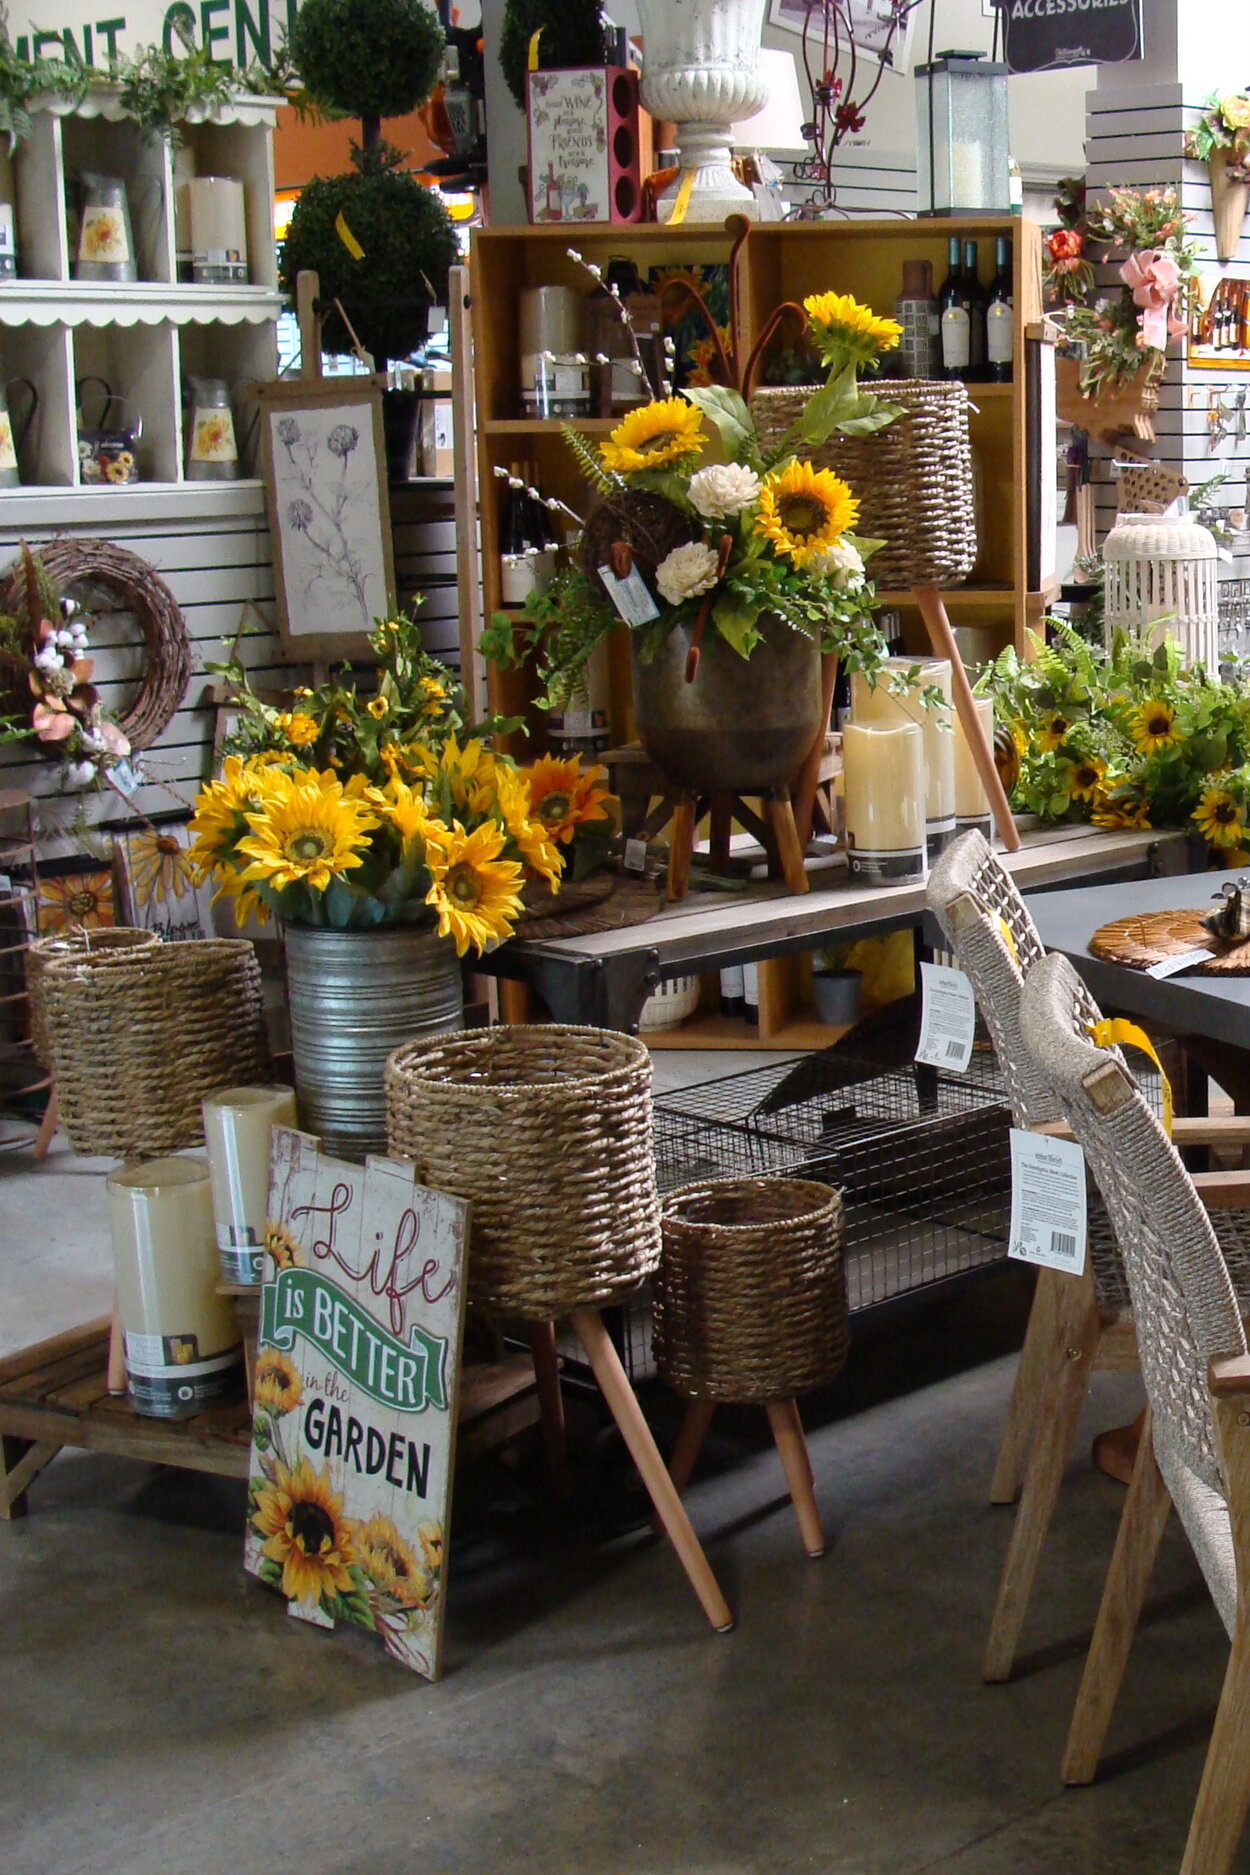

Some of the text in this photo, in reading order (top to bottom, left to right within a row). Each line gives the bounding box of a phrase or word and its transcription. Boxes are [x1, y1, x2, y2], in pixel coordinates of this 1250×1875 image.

[291, 1183, 455, 1335] Life
[284, 1279, 417, 1404] is BETTER
[305, 1371, 349, 1403] in the
[304, 1398, 431, 1500] GARDEN
